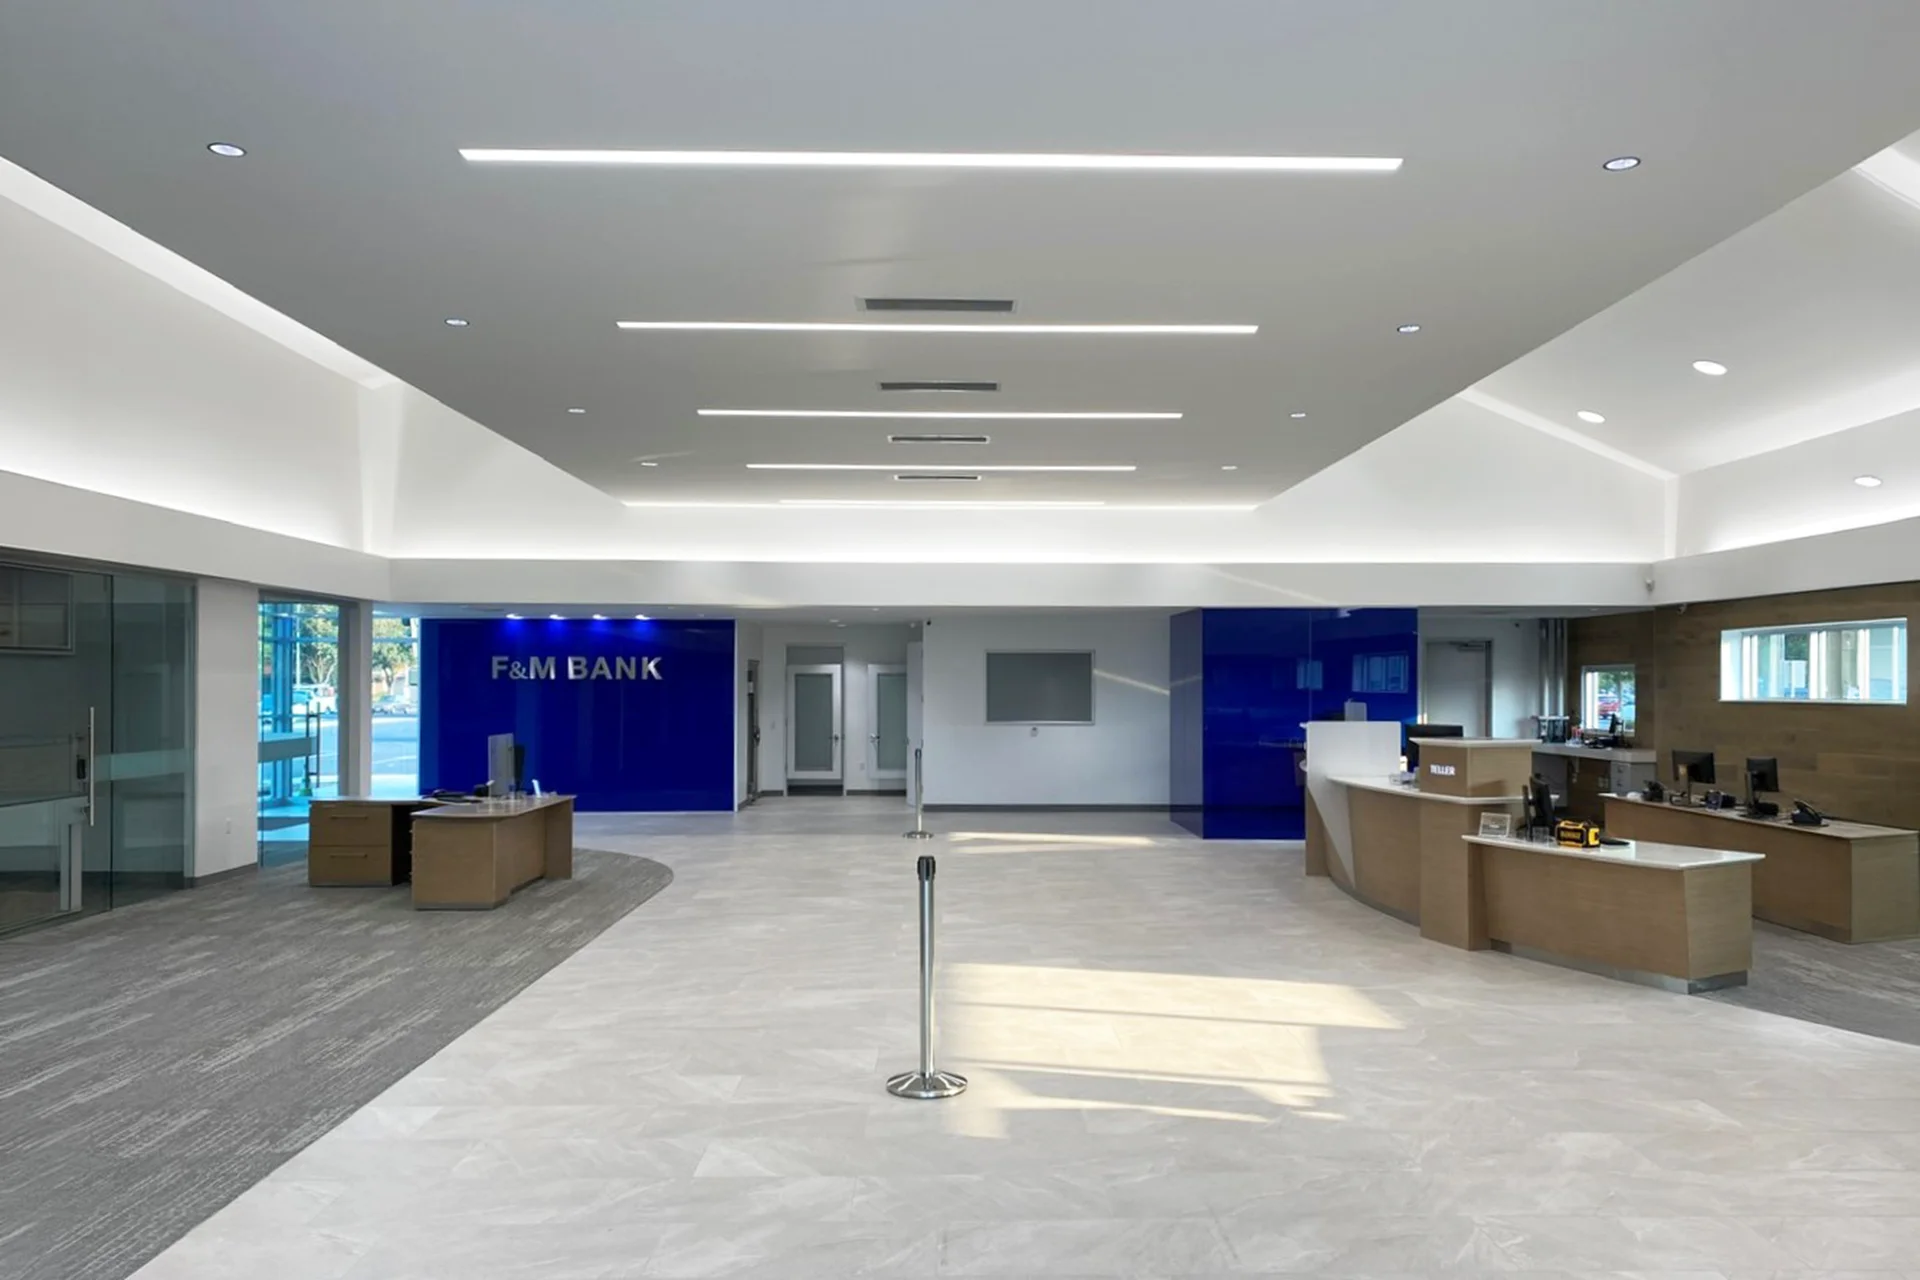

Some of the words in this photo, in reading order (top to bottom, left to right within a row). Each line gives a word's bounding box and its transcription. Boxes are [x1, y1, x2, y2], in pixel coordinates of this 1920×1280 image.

[491, 655, 556, 680] F&M
[567, 655, 663, 680] BANK
[1430, 763, 1456, 776] TELLER
